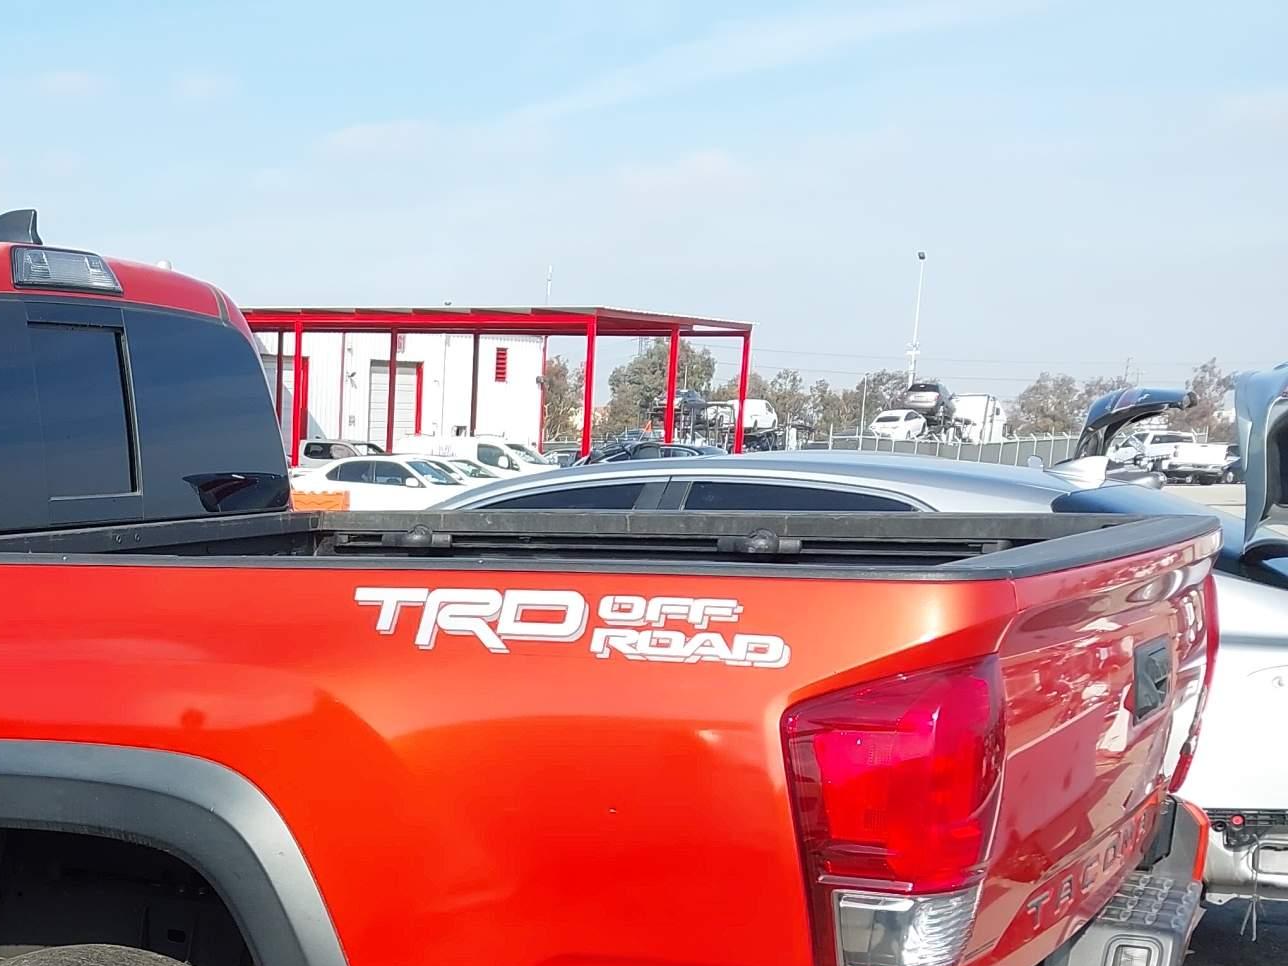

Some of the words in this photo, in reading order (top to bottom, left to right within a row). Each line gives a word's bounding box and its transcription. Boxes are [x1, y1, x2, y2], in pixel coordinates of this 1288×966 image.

[354, 586, 589, 653] TRD
[597, 595, 744, 629] OFF
[589, 627, 792, 669] ROAD
